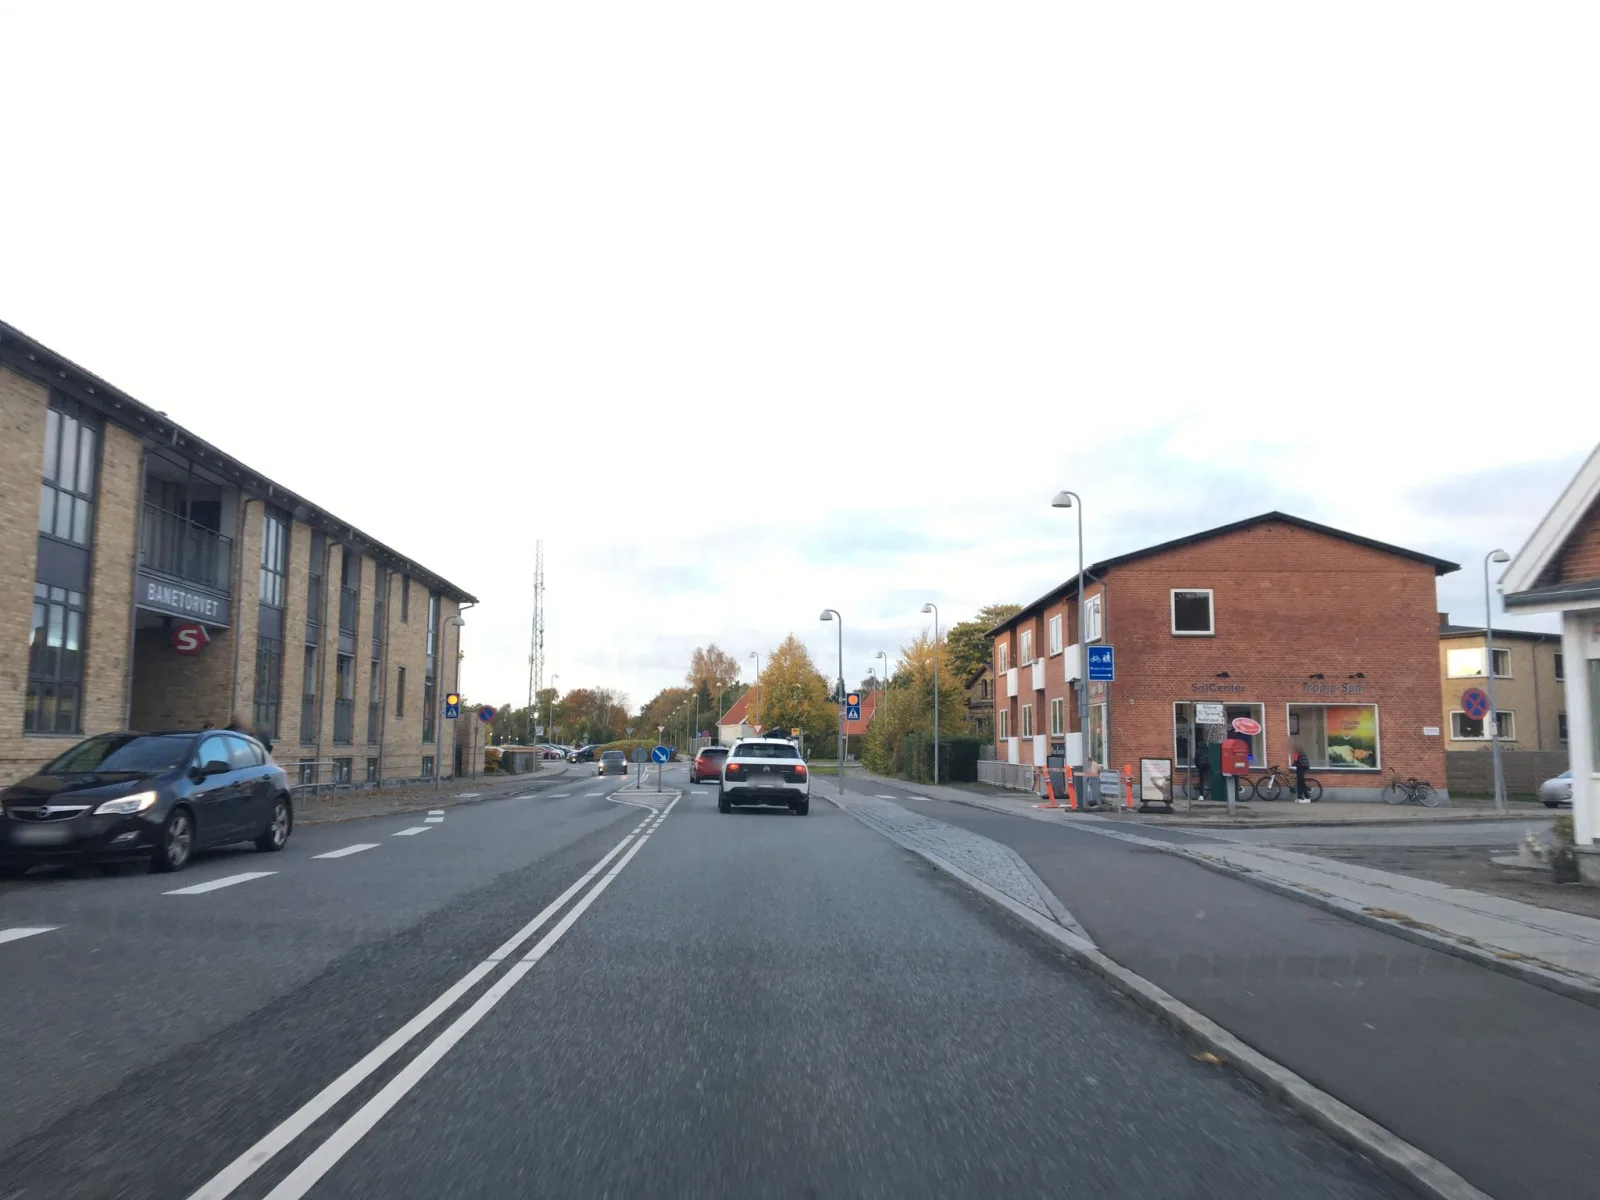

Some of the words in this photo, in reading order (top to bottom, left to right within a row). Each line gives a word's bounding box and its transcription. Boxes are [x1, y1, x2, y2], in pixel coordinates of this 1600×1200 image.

[147, 583, 218, 616] BANETORVET
[177, 629, 198, 650] S
[1191, 682, 1246, 693] SolCenter
[1342, 682, 1365, 694] Sun
